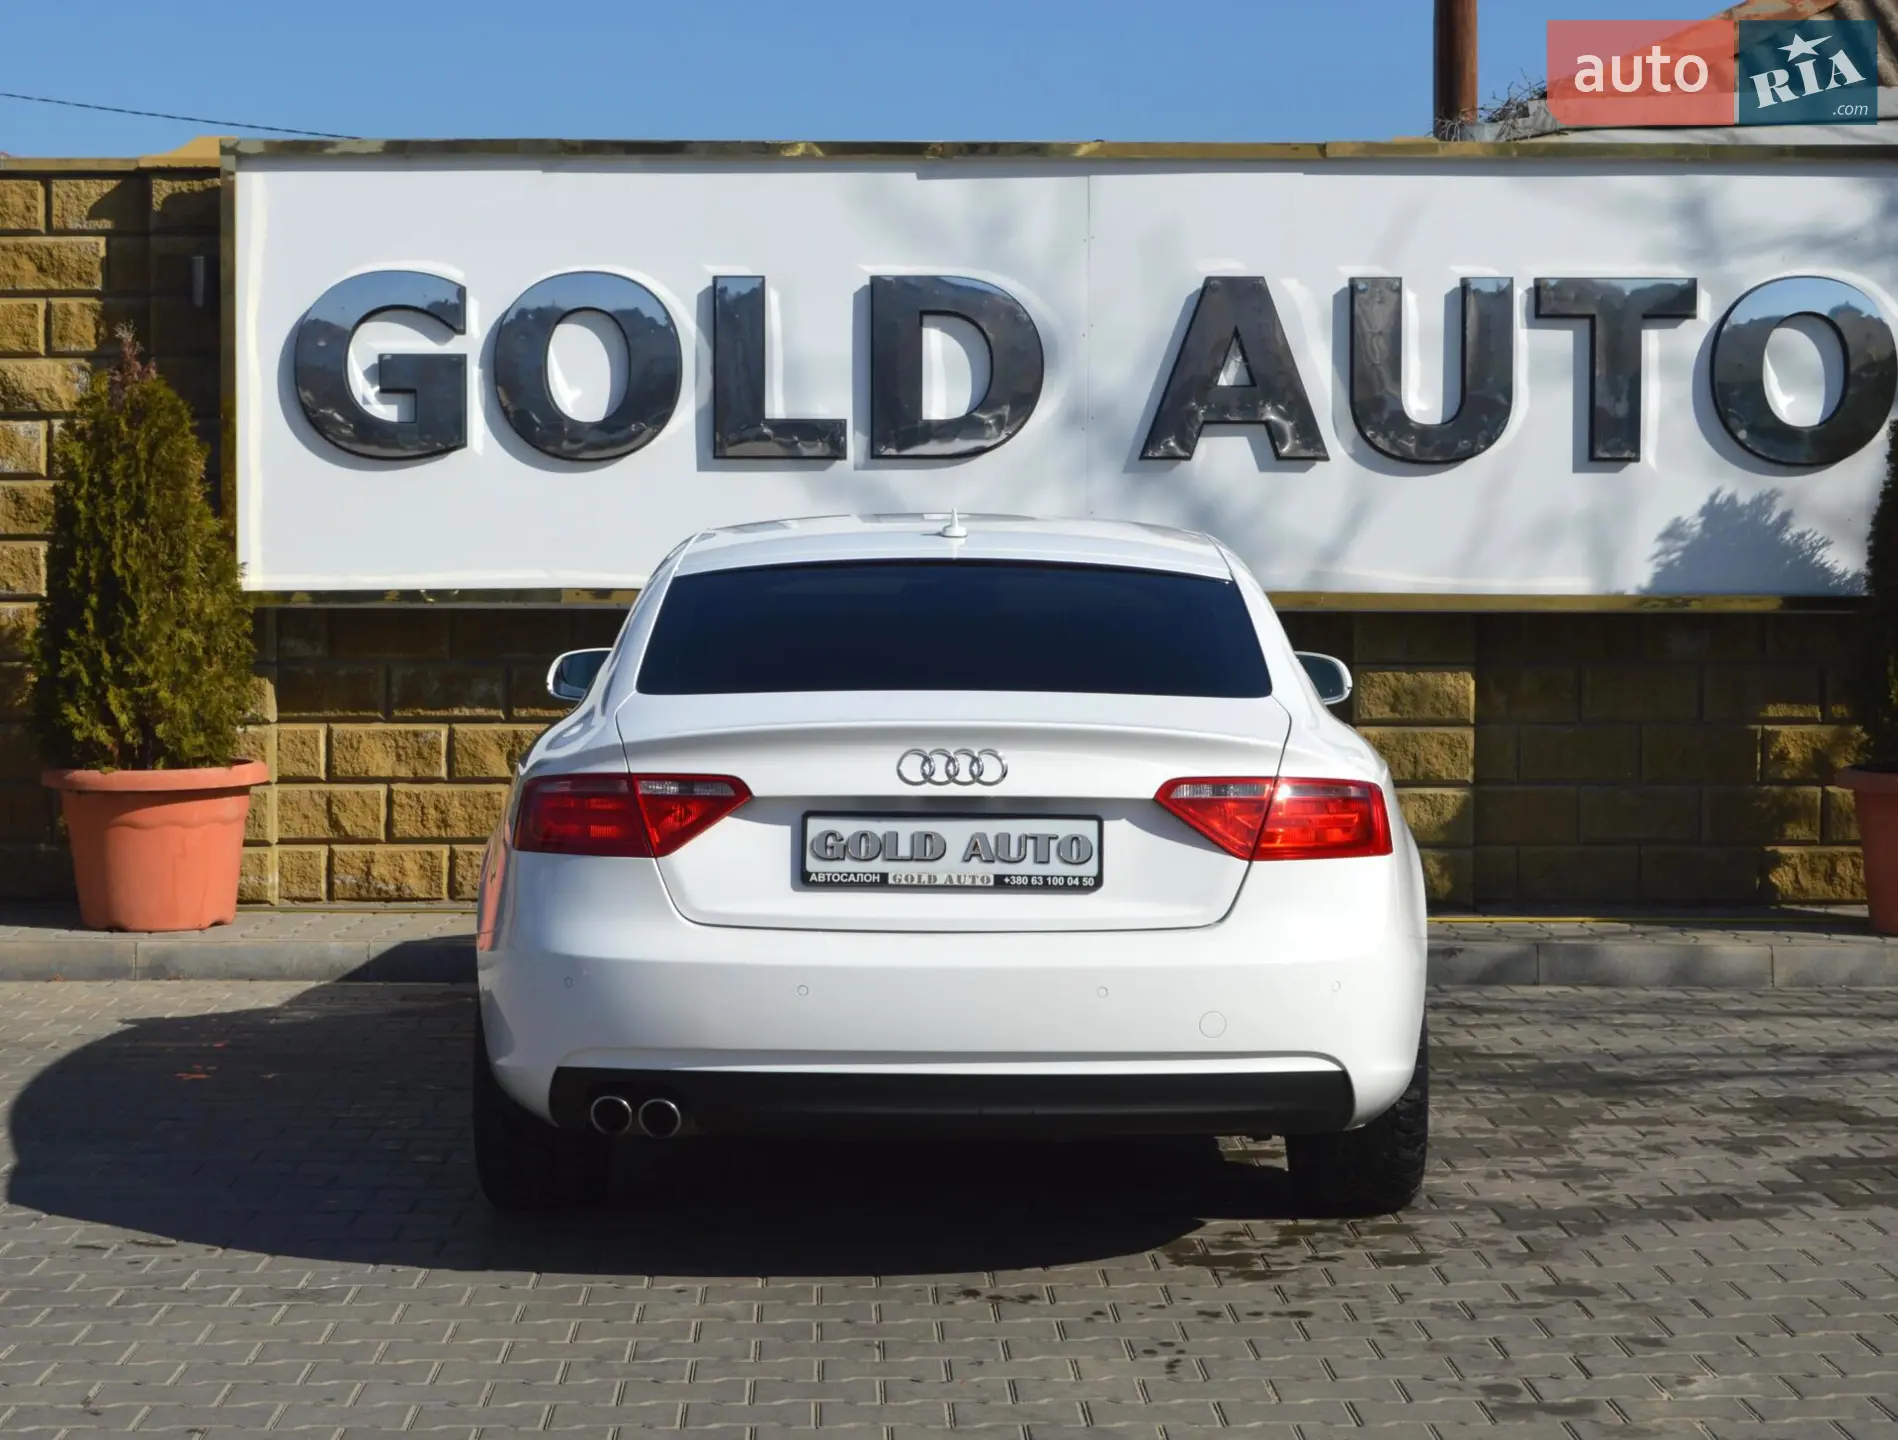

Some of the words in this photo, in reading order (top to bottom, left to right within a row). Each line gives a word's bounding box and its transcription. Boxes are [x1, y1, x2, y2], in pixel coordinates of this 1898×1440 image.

[294, 269, 1044, 462] GOLD
[1139, 275, 1898, 466] AUTO
[810, 830, 946, 861] GOLD
[962, 832, 1093, 864] AUTO
[809, 872, 881, 884] АВТОСАЛОН
[891, 873, 938, 885] GOLD
[944, 874, 991, 885] AUTO
[1003, 876, 1029, 887] +380
[1031, 876, 1044, 887] 63
[1047, 876, 1065, 887] 100
[1067, 876, 1080, 887] 04
[1082, 876, 1094, 887] 50
